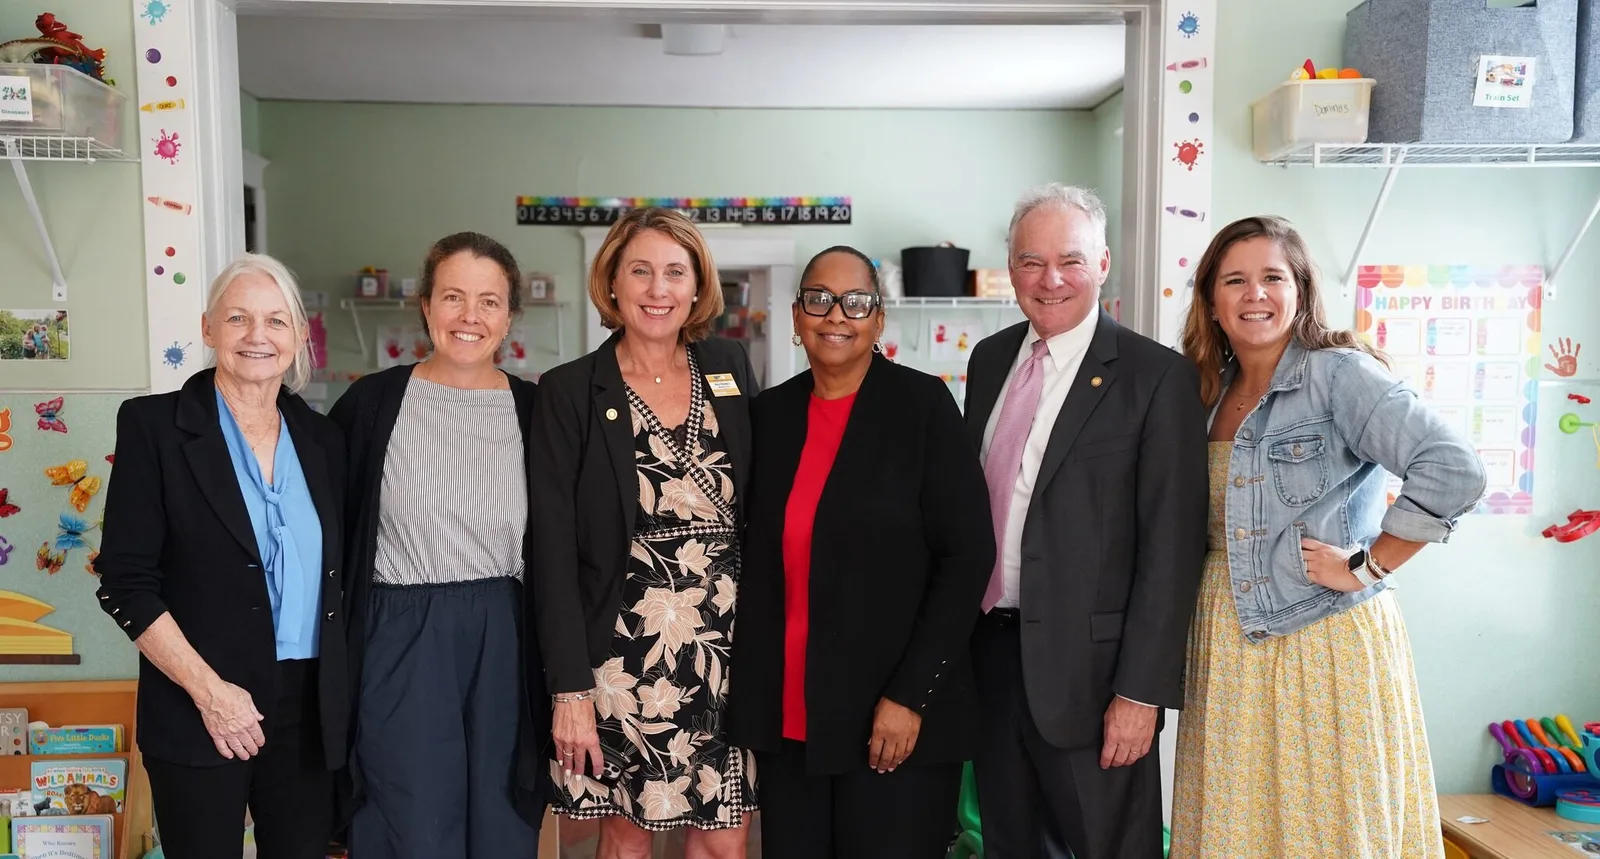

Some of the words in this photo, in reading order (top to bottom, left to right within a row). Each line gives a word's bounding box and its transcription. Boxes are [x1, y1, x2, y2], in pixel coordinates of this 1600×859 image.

[1485, 93, 1506, 101] Train
[706, 207, 720, 222] 13
[726, 207, 742, 221] 14
[743, 207, 757, 221] 15
[762, 207, 776, 221] 16
[781, 207, 795, 220] 17
[798, 207, 811, 220] 18
[815, 206, 828, 220] 19
[831, 206, 850, 220] 20
[1375, 296, 1432, 310] HAPPY
[50, 734, 65, 742] Five
[66, 734, 87, 742] Little
[89, 733, 109, 741] Ducks
[35, 774, 65, 787] WILD
[66, 773, 117, 786] ANIMALS
